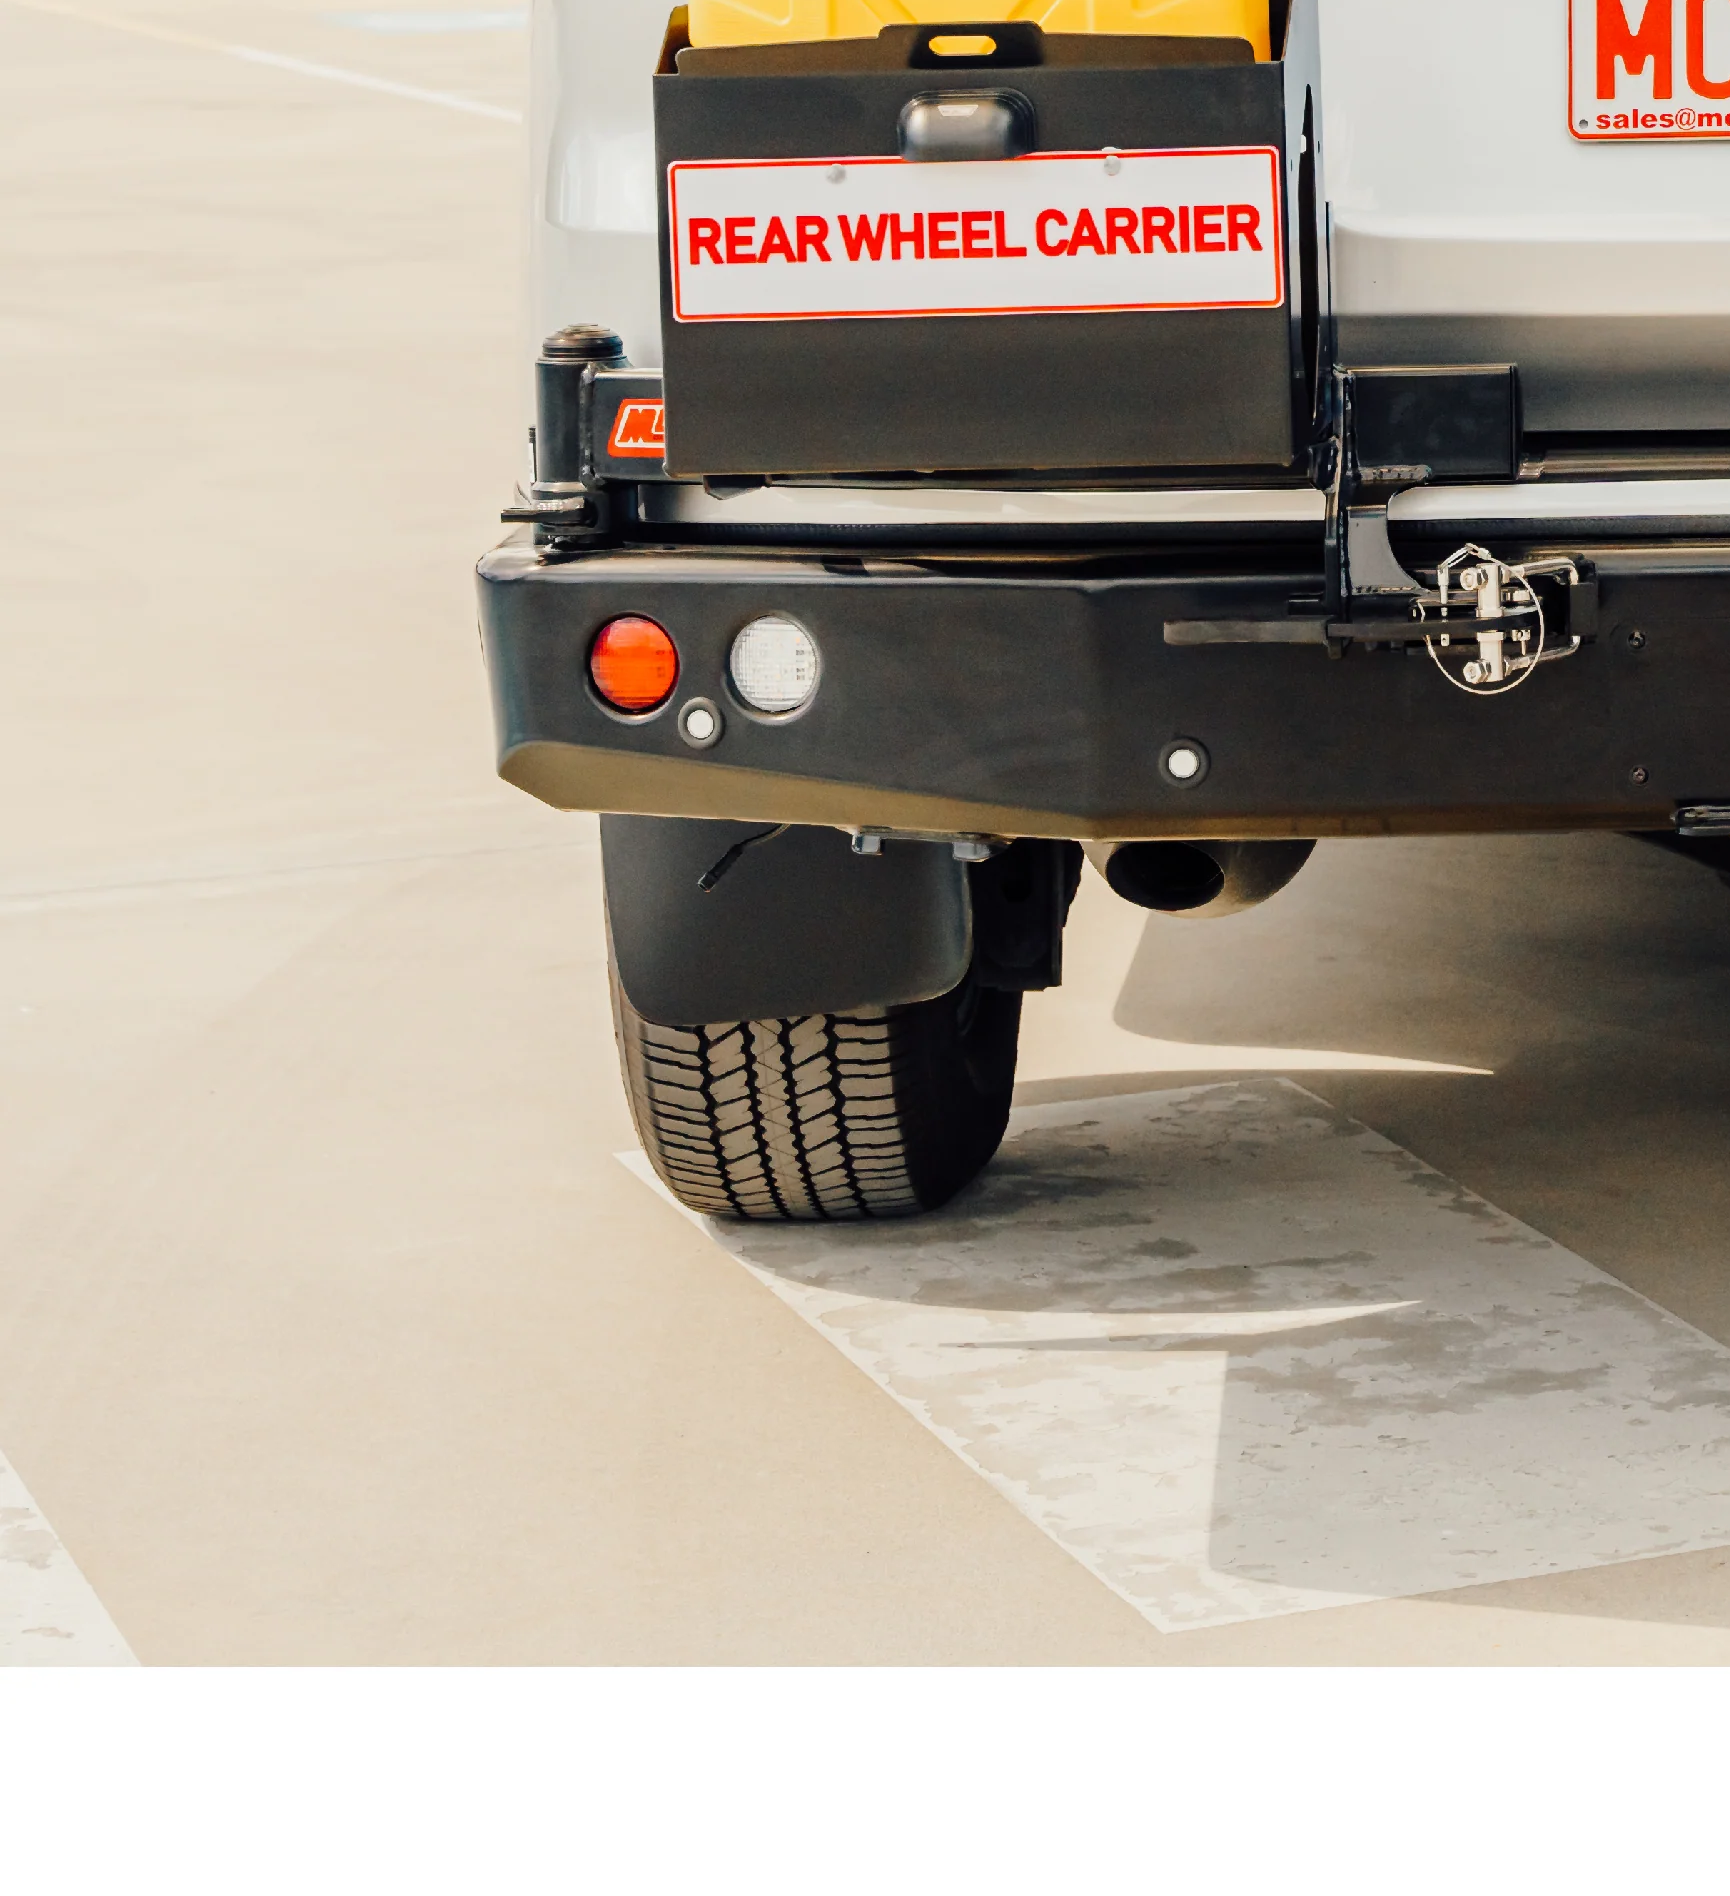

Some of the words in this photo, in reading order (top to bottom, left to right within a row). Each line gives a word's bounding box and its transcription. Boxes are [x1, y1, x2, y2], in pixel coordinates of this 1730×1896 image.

[689, 216, 831, 266] REAR
[836, 211, 1028, 264] WHEEL
[1035, 204, 1263, 258] CARRIER
